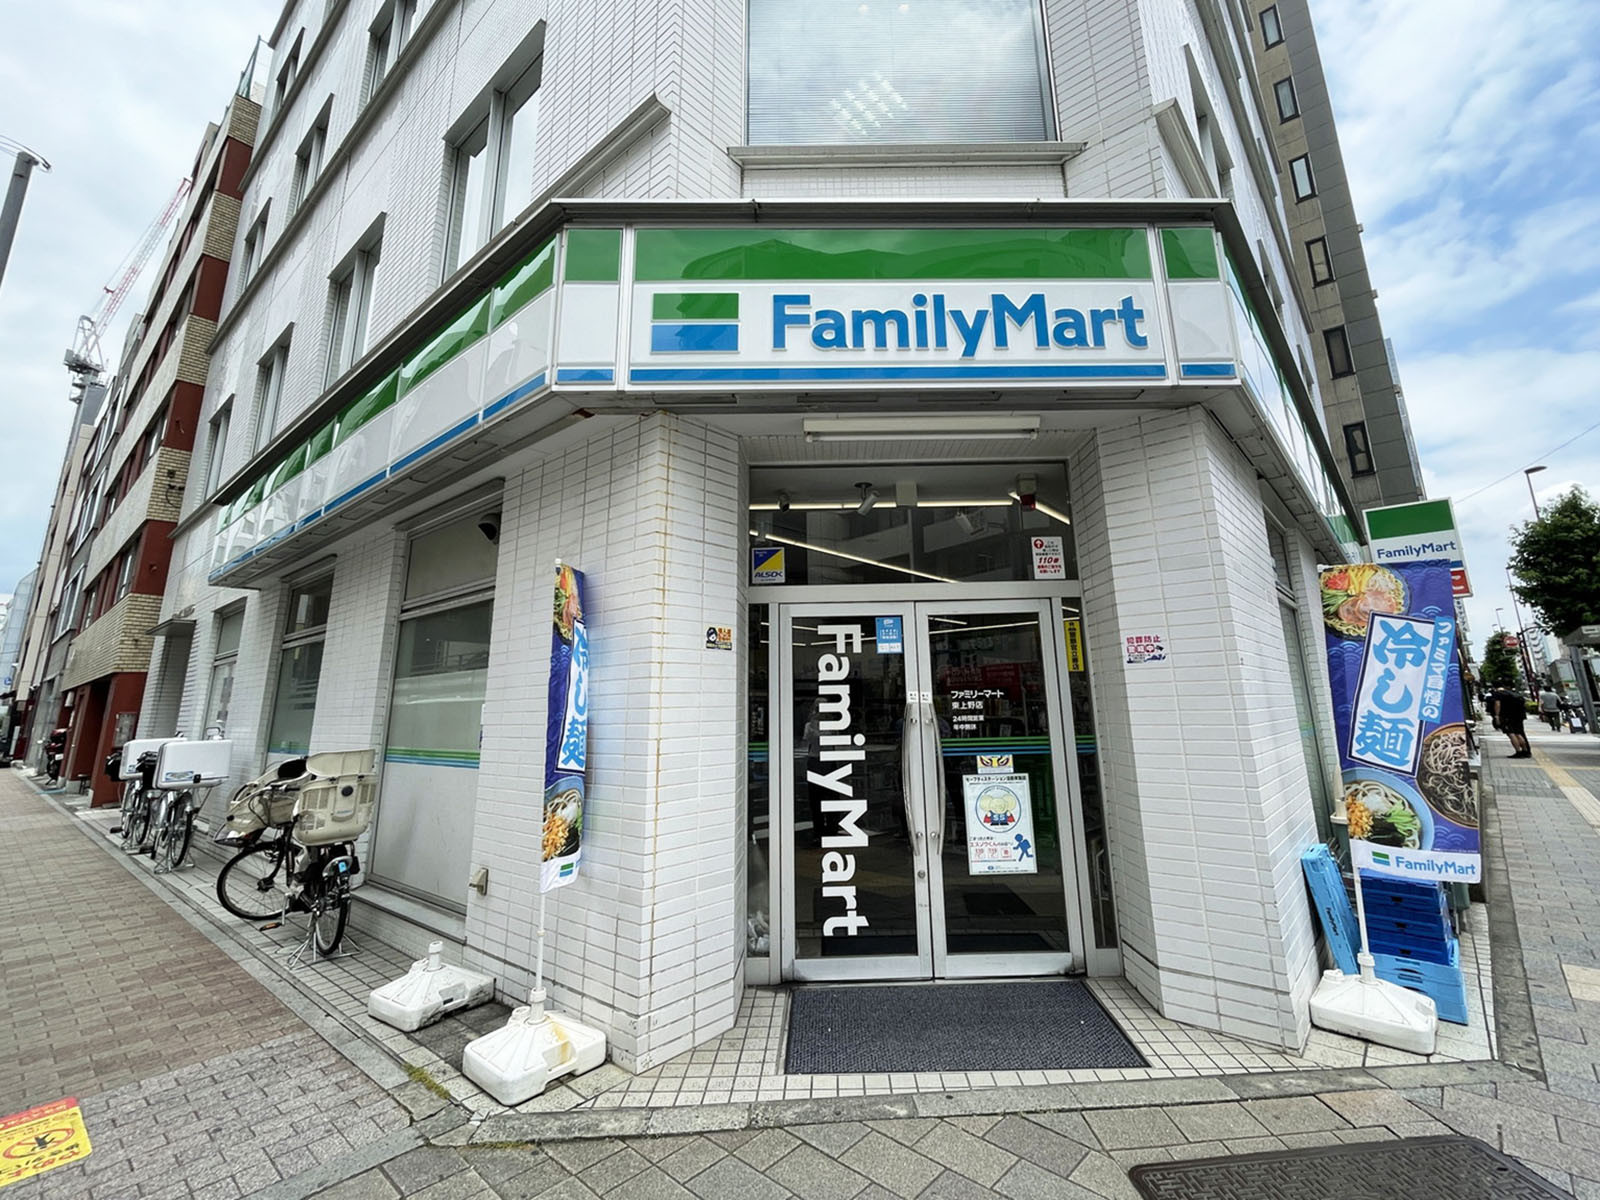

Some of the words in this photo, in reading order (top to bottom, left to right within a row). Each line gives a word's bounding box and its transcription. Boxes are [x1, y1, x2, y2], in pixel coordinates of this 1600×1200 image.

[772, 293, 1149, 358] FamilyMart
[1376, 541, 1456, 559] FamilyMart
[950, 689, 1005, 699] ファミリーマート
[1355, 620, 1431, 767] 冷し麺
[951, 701, 984, 710] 東上野店
[952, 714, 985, 723] 24時間営業
[807, 623, 870, 937] FamilyMart
[1395, 855, 1476, 875] FamilyMart
